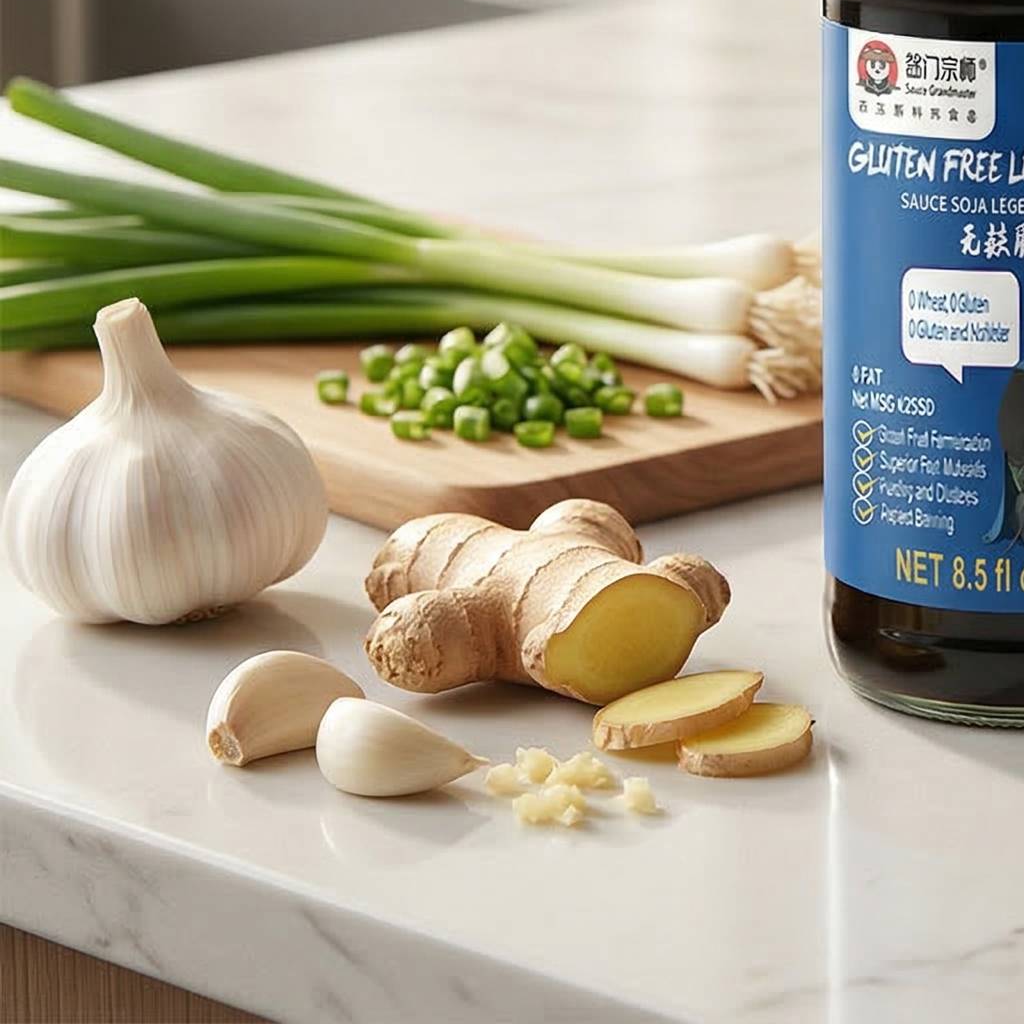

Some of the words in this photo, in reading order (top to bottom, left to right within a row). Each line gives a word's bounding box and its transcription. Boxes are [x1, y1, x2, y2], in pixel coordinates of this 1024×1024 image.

[848, 141, 937, 182] GLUTEN
[942, 148, 1003, 184] FREE
[901, 192, 948, 212] SAUCE
[951, 195, 988, 214] SOJA
[895, 547, 944, 587] NET
[953, 556, 988, 592] 8.5
[995, 558, 1011, 592] fl
